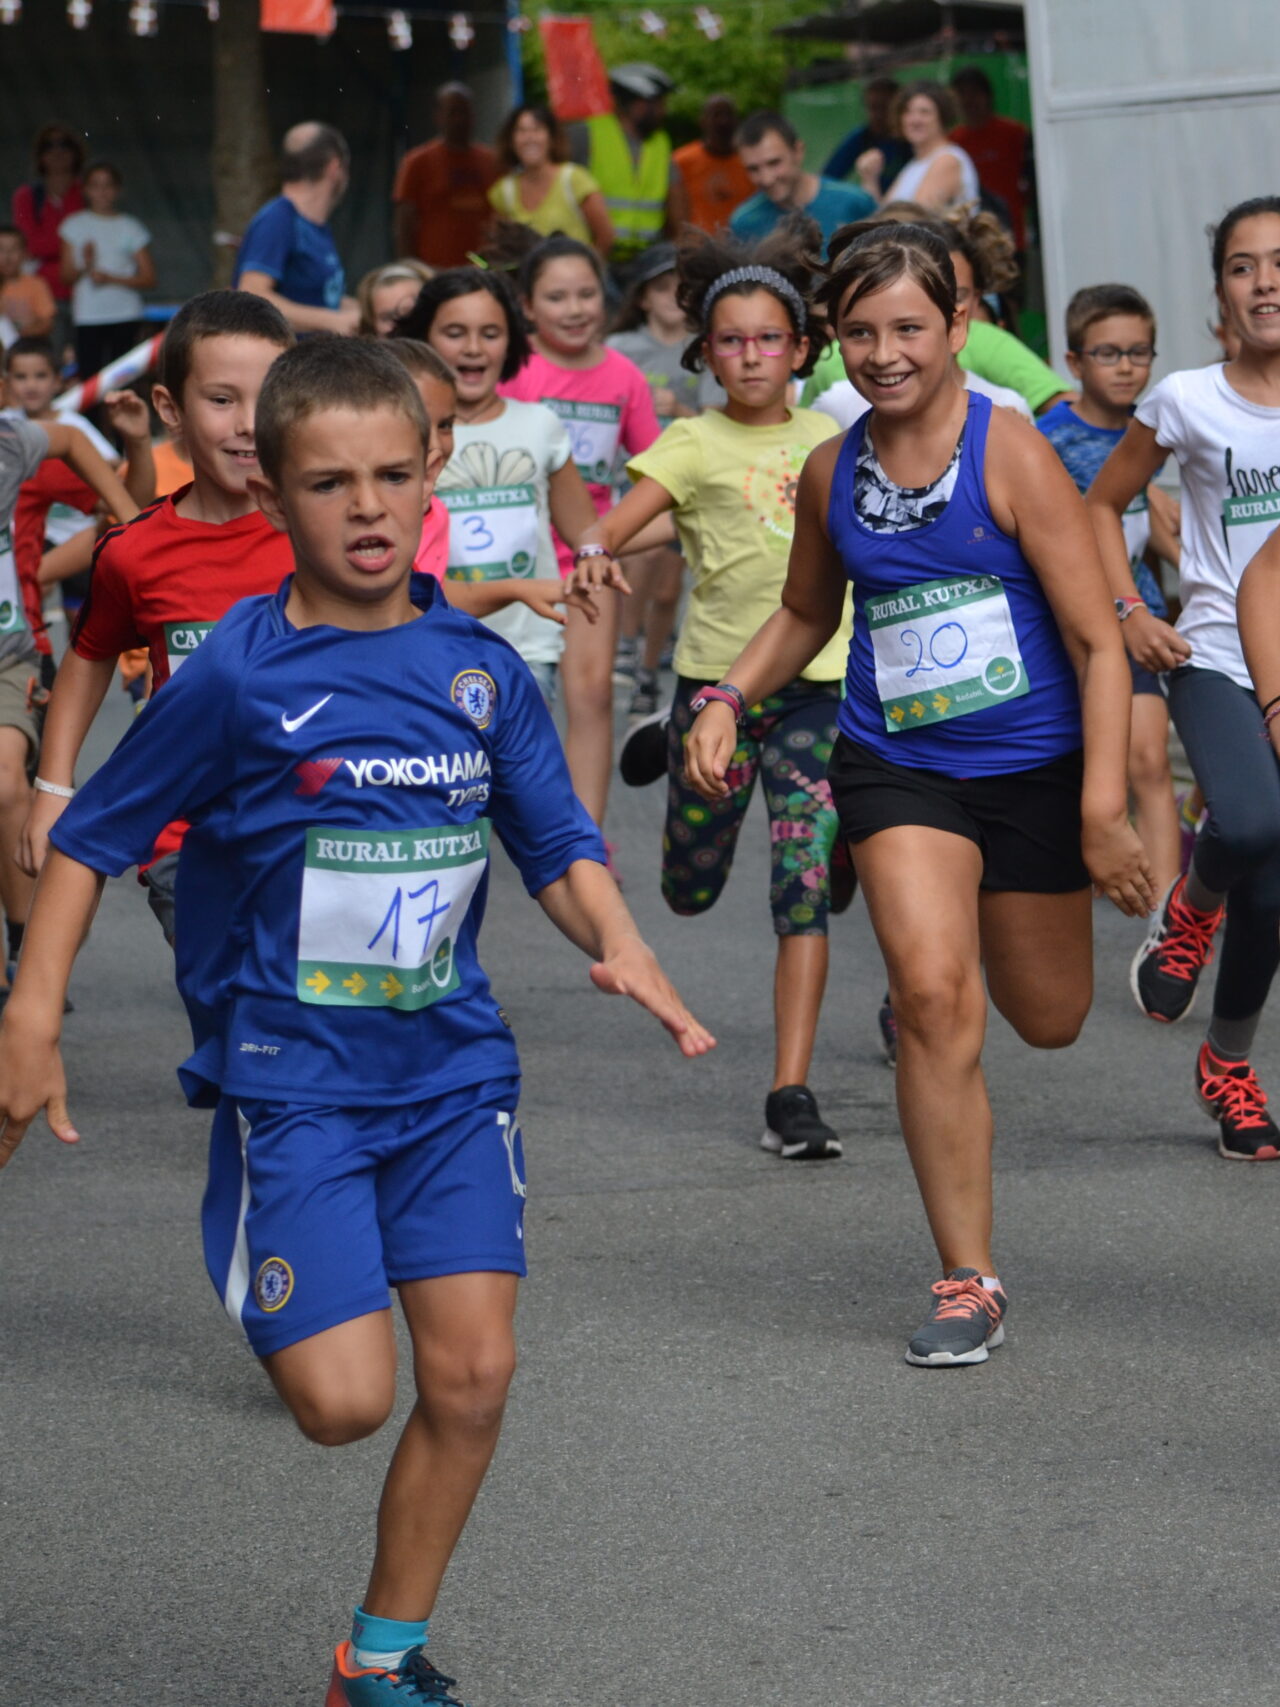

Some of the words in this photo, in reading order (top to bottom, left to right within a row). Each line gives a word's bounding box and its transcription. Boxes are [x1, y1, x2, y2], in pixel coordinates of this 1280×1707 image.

[476, 487, 530, 505] KUTXA
[462, 514, 494, 551] 3
[870, 595, 921, 622] RURAL
[921, 577, 994, 607] KUTXA
[900, 621, 968, 678] 20
[344, 749, 491, 788] YOKOHAMA
[316, 837, 408, 862] RURAL
[412, 830, 482, 860] KUTXA
[367, 879, 451, 961] 17
